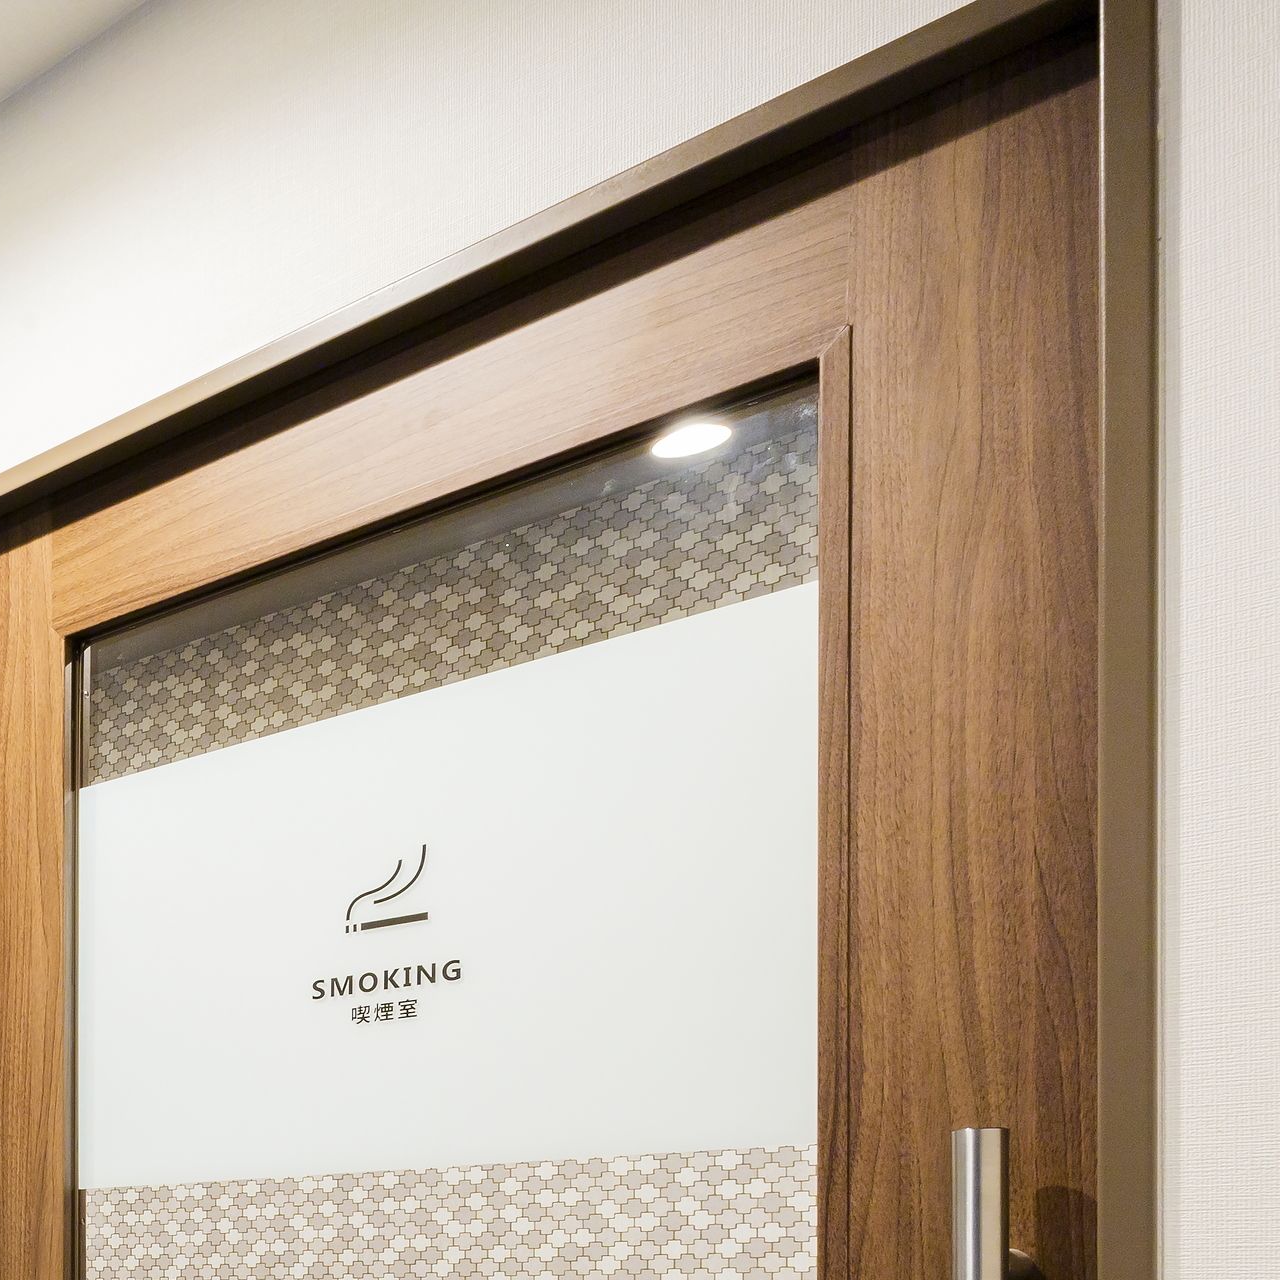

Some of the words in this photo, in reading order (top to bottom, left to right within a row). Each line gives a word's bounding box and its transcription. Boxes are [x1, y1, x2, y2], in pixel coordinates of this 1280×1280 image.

[312, 959, 462, 1000] SMOKING
[351, 999, 418, 1025] 喫煙室
